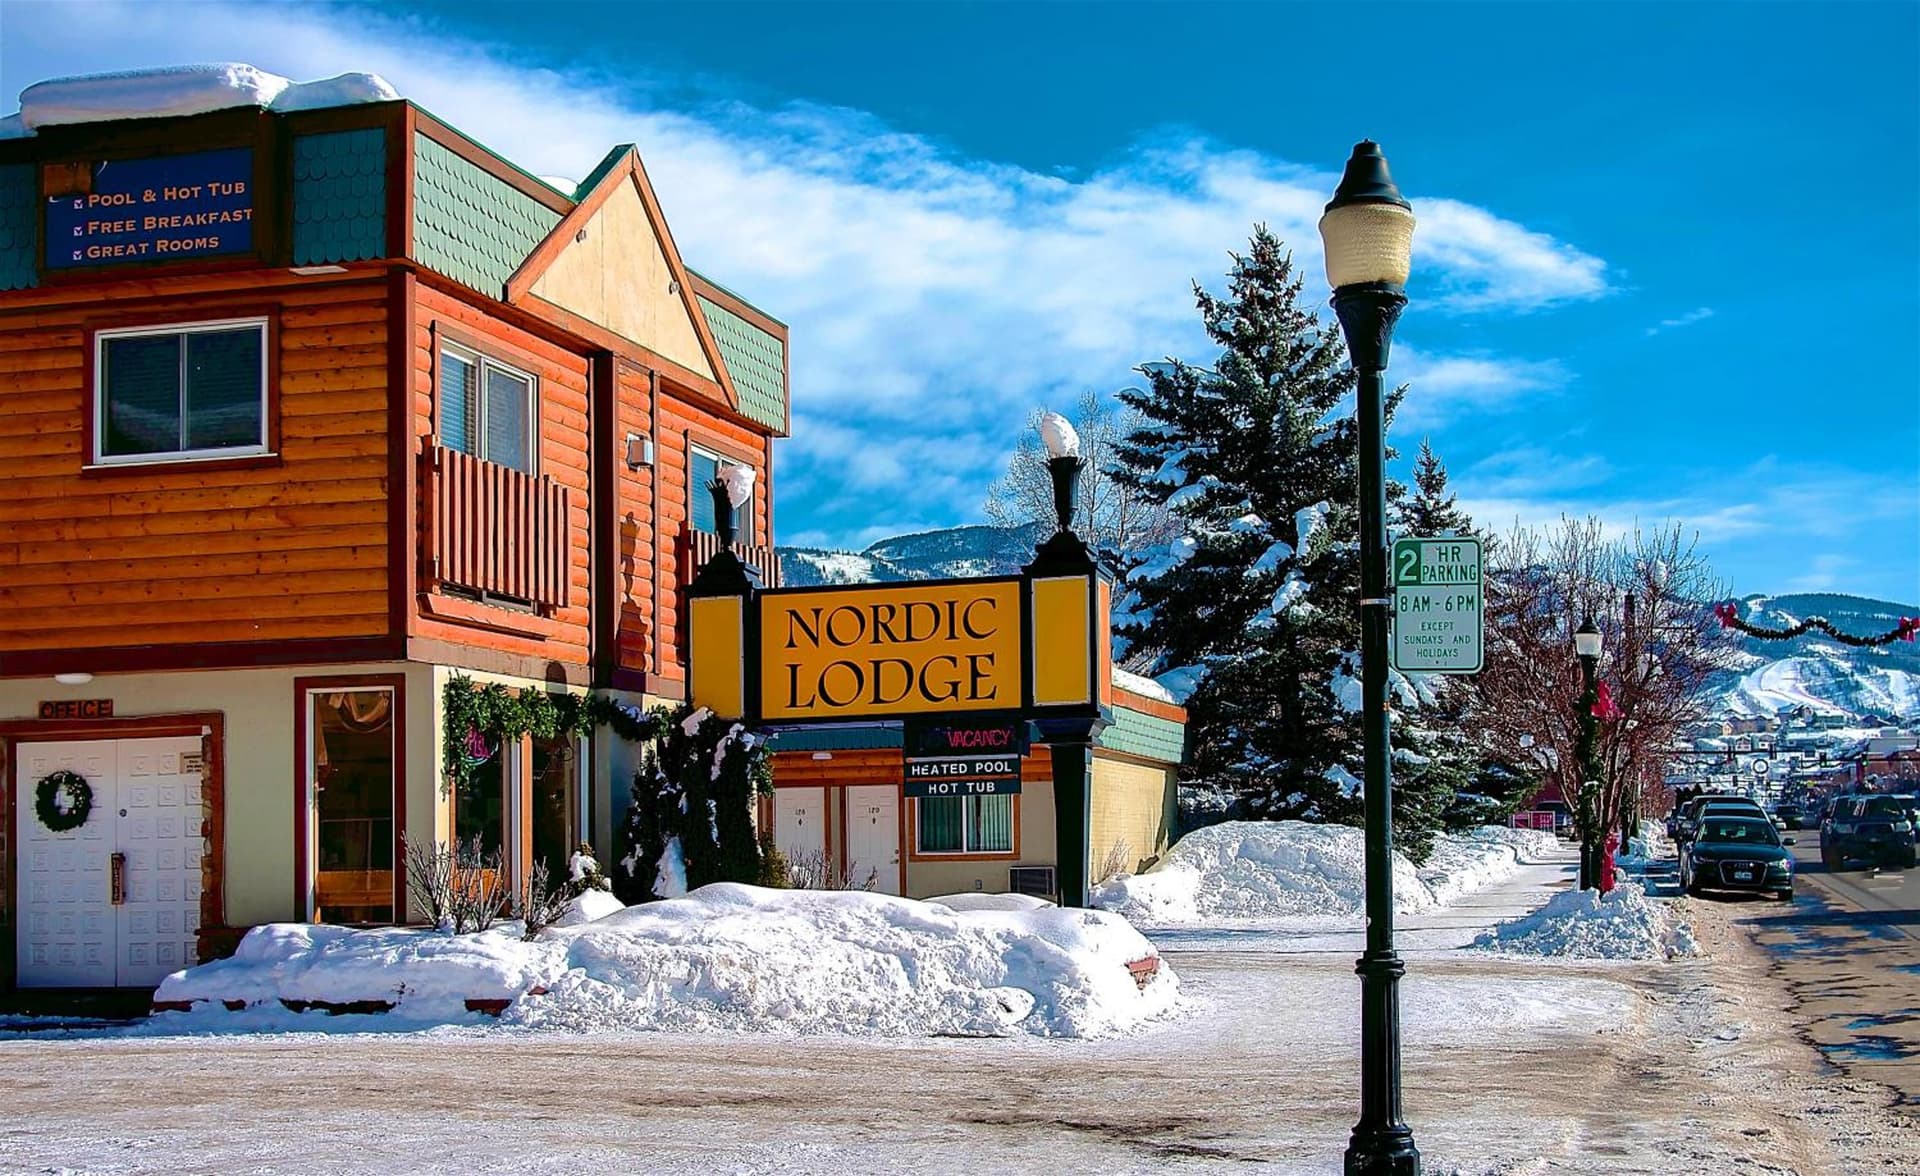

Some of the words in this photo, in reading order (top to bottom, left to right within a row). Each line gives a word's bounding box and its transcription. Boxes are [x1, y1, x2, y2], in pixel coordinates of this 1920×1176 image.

[87, 192, 136, 208] POOL
[142, 189, 156, 203] &
[163, 186, 202, 201] HOT
[207, 182, 246, 197] TUB
[87, 219, 137, 235] FREE
[143, 208, 253, 231] BREAKFAST
[86, 242, 150, 259] GREAT
[156, 236, 220, 253] ROOMS
[1438, 546, 1461, 562] HR
[1399, 548, 1418, 582] 2
[1422, 564, 1477, 582] PARKING
[783, 597, 999, 650] NORDIC
[1421, 621, 1455, 632] EXCEPT
[1404, 635, 1444, 645] SUNDAYS
[1452, 634, 1472, 644] AND
[1416, 648, 1459, 658] HOLIDAYS
[783, 652, 999, 710] LODGE
[41, 701, 111, 718] OFFICE
[947, 729, 1011, 747] VACANCY
[911, 763, 968, 776] HEATED
[975, 761, 1012, 773] POOL
[928, 782, 959, 795] HOT
[966, 781, 996, 793] TUB
